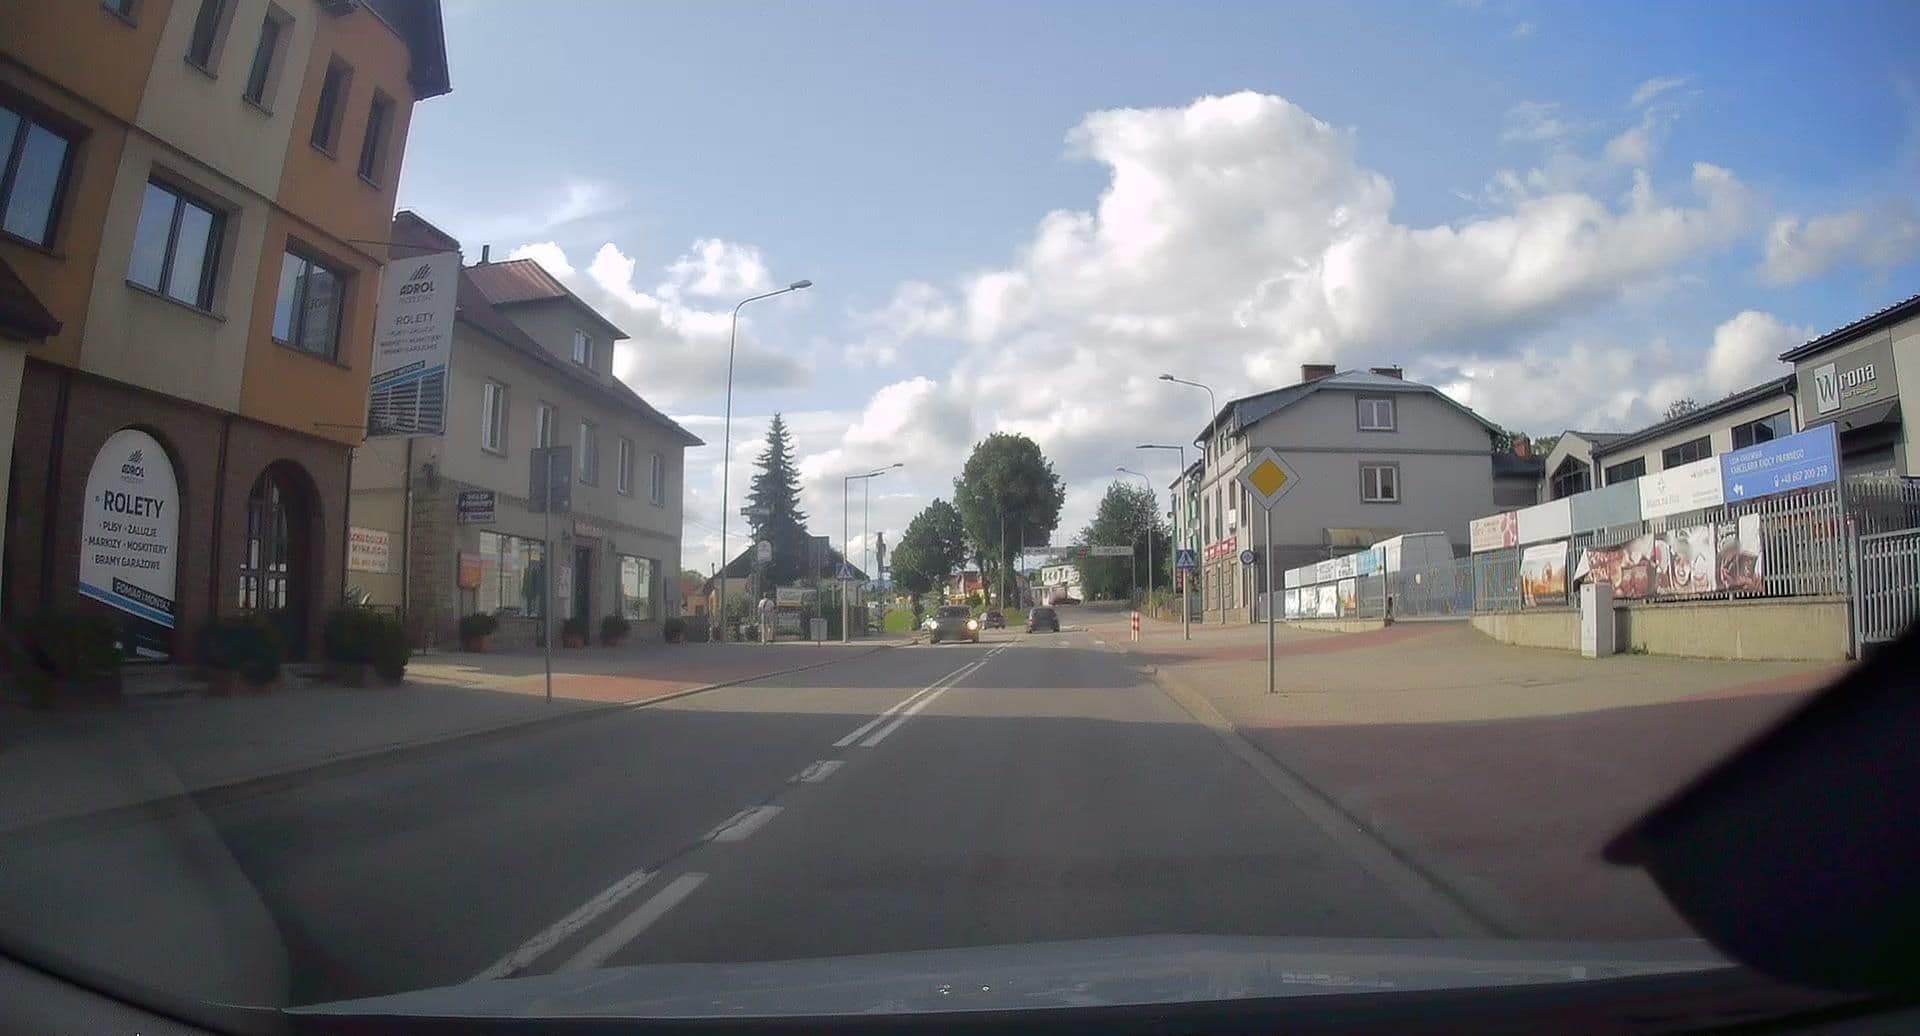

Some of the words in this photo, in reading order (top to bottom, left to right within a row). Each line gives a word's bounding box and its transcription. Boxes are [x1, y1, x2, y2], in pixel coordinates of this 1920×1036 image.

[400, 281, 435, 296] ADROL
[396, 312, 435, 326] ROLETY
[1816, 364, 1876, 404] Wrona
[104, 490, 165, 519] ROLETY
[103, 521, 123, 533] PLISY
[88, 536, 122, 549] MARKIZY
[127, 541, 169, 555] MOSKITIERY
[95, 554, 121, 567] BRAMY
